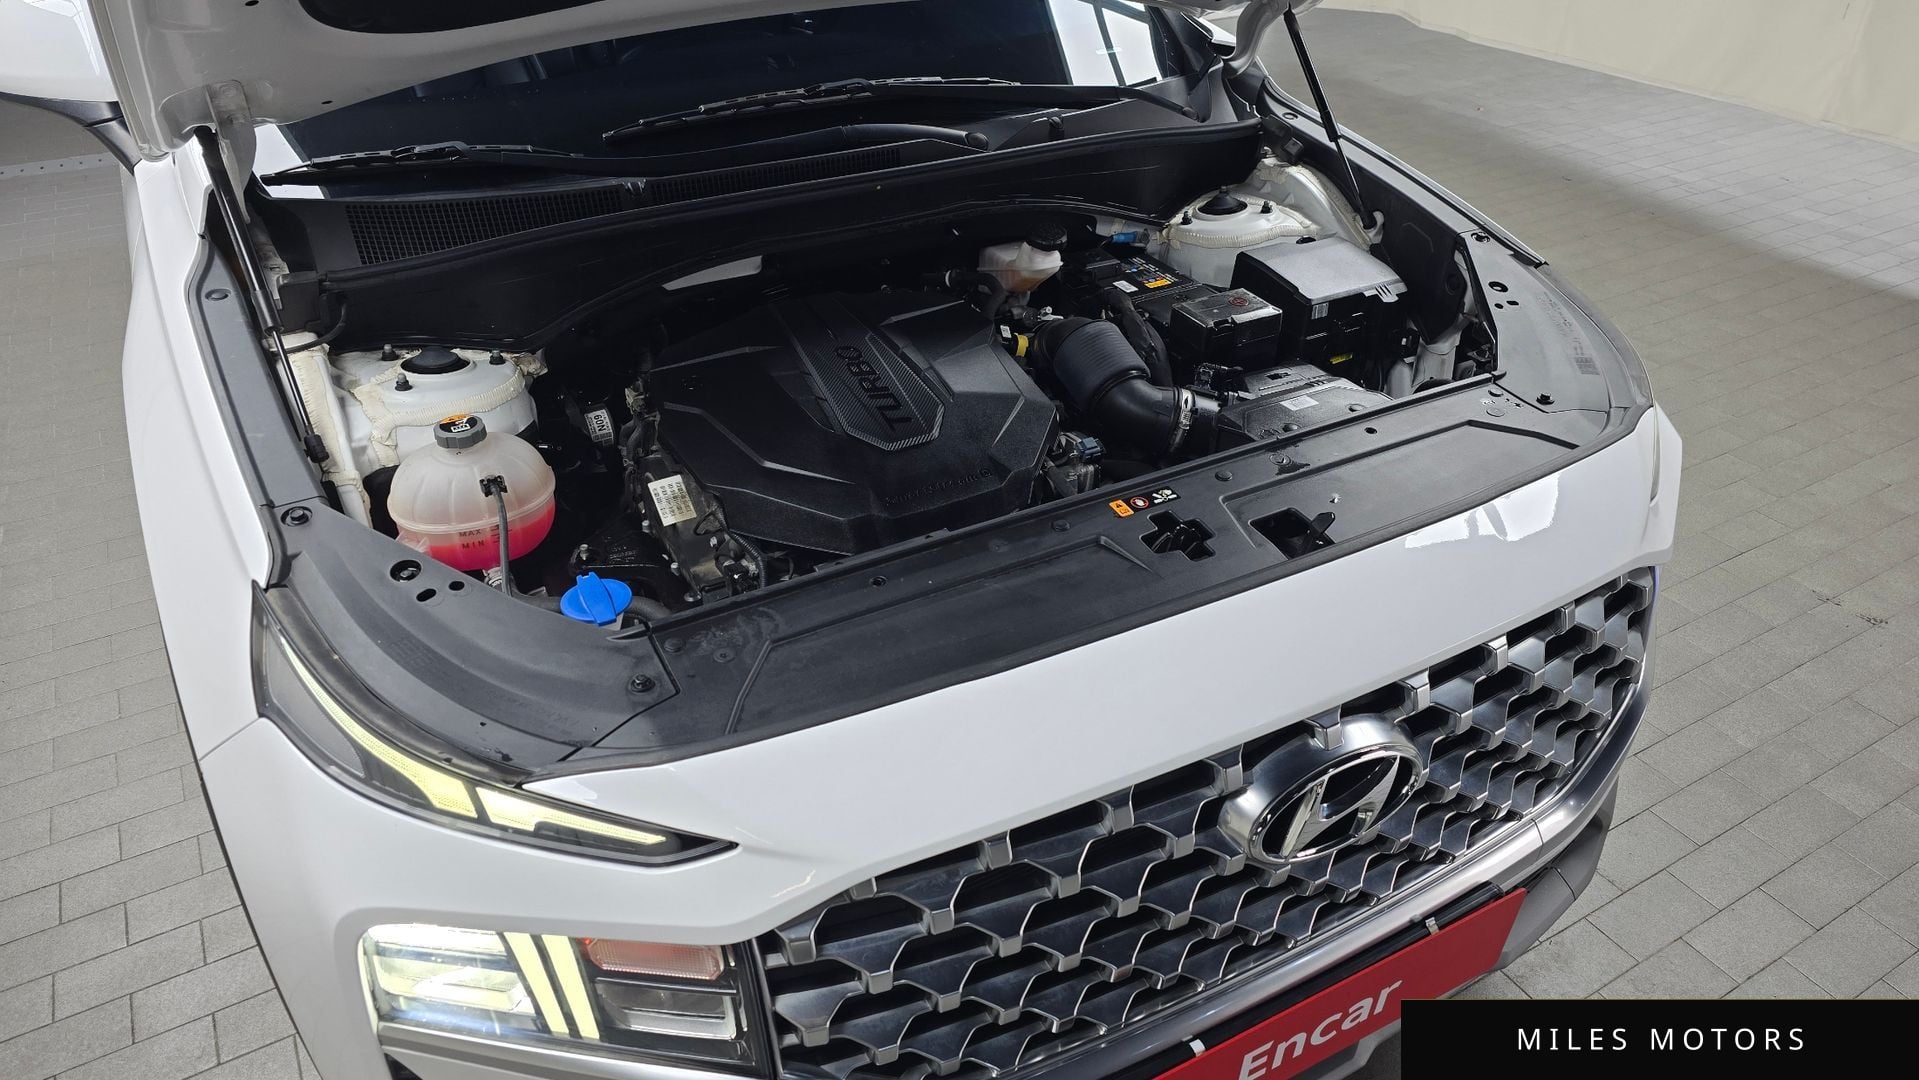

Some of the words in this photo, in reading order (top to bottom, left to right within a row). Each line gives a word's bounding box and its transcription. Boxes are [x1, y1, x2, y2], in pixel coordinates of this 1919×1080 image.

[837, 345, 914, 432] TURBO
[593, 414, 607, 432] 60N
[458, 528, 482, 537] MAX
[461, 540, 485, 549] MIN
[1238, 980, 1403, 1080] Encar
